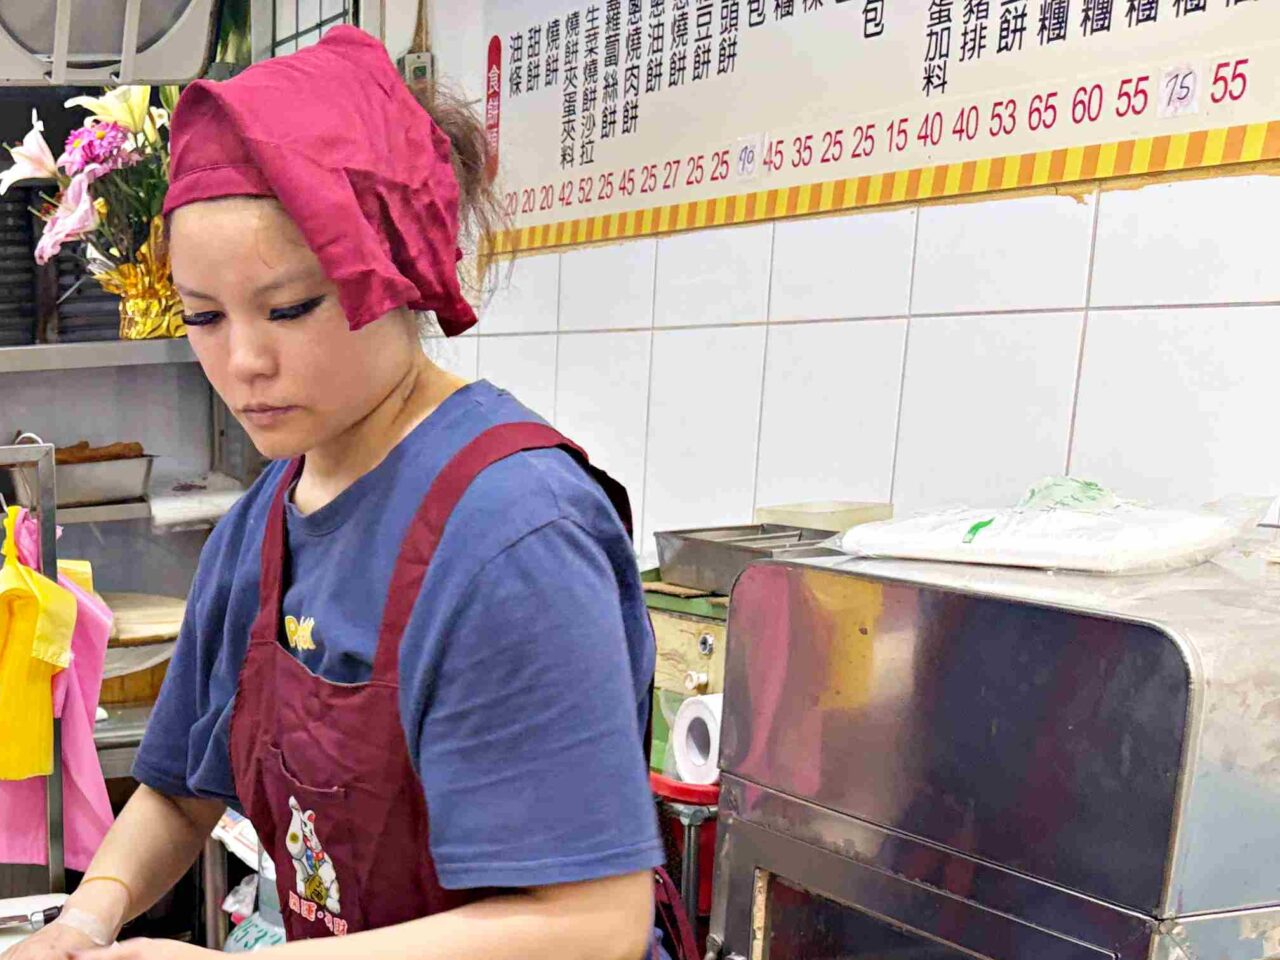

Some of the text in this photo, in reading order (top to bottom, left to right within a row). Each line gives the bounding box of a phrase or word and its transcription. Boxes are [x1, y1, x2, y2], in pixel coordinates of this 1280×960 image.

[509, 34, 523, 97] 油條
[527, 26, 542, 92] 甜餅
[545, 19, 560, 87] 燒餅
[668, 0, 689, 88] 燒餅
[692, 0, 714, 81] 豆餅
[996, 0, 1028, 54] 餅
[561, 11, 580, 169] 燒餅夾蛋夾料
[580, 5, 600, 166] 生菜燒餅沙拉
[521, 188, 536, 214] 20
[539, 184, 555, 211] 20
[558, 180, 573, 206] 42
[578, 177, 593, 204] 52
[597, 172, 614, 200] 25
[618, 168, 636, 196] 45
[640, 164, 658, 194] 25
[662, 160, 681, 191] 27
[685, 155, 705, 186] 25
[709, 150, 731, 182] 25
[762, 139, 785, 172] 45
[792, 134, 814, 168] 35
[820, 129, 844, 164] 25
[851, 123, 876, 159] 25
[886, 117, 909, 152] 15
[917, 111, 943, 146] 40
[952, 105, 979, 142] 40
[989, 99, 1017, 137] 53
[1028, 92, 1058, 131] 65
[1071, 83, 1103, 124] 60
[1115, 76, 1150, 118] 55
[1210, 58, 1249, 104] 55
